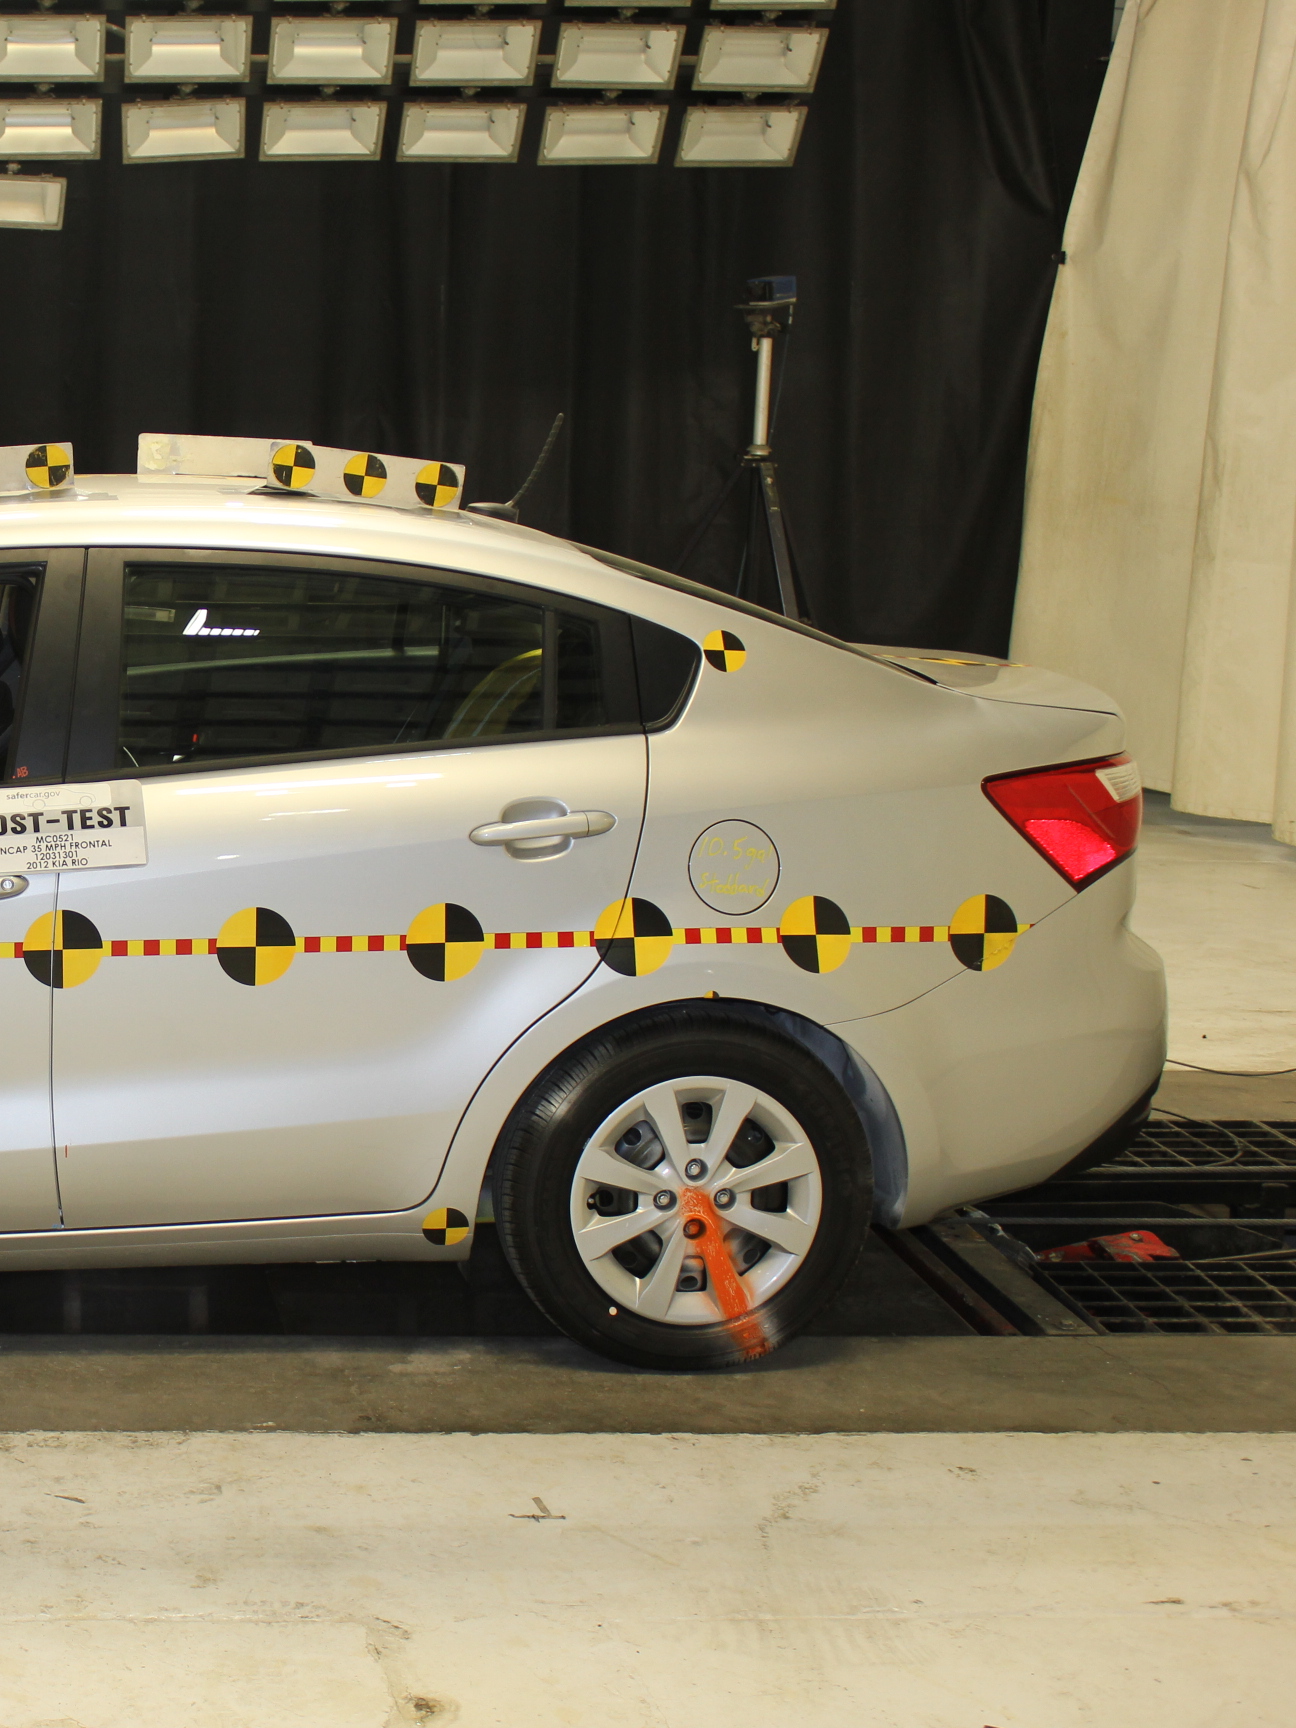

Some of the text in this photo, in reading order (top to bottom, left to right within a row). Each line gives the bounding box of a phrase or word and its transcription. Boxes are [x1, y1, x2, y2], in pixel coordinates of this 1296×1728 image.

[6, 790, 61, 801] safercar.gov
[35, 834, 74, 844] MC0521
[0, 839, 112, 855] NCAP 35 MPH FRONTAL
[34, 850, 78, 861] 12031301
[26, 857, 89, 870] 2012 KIA RIO
